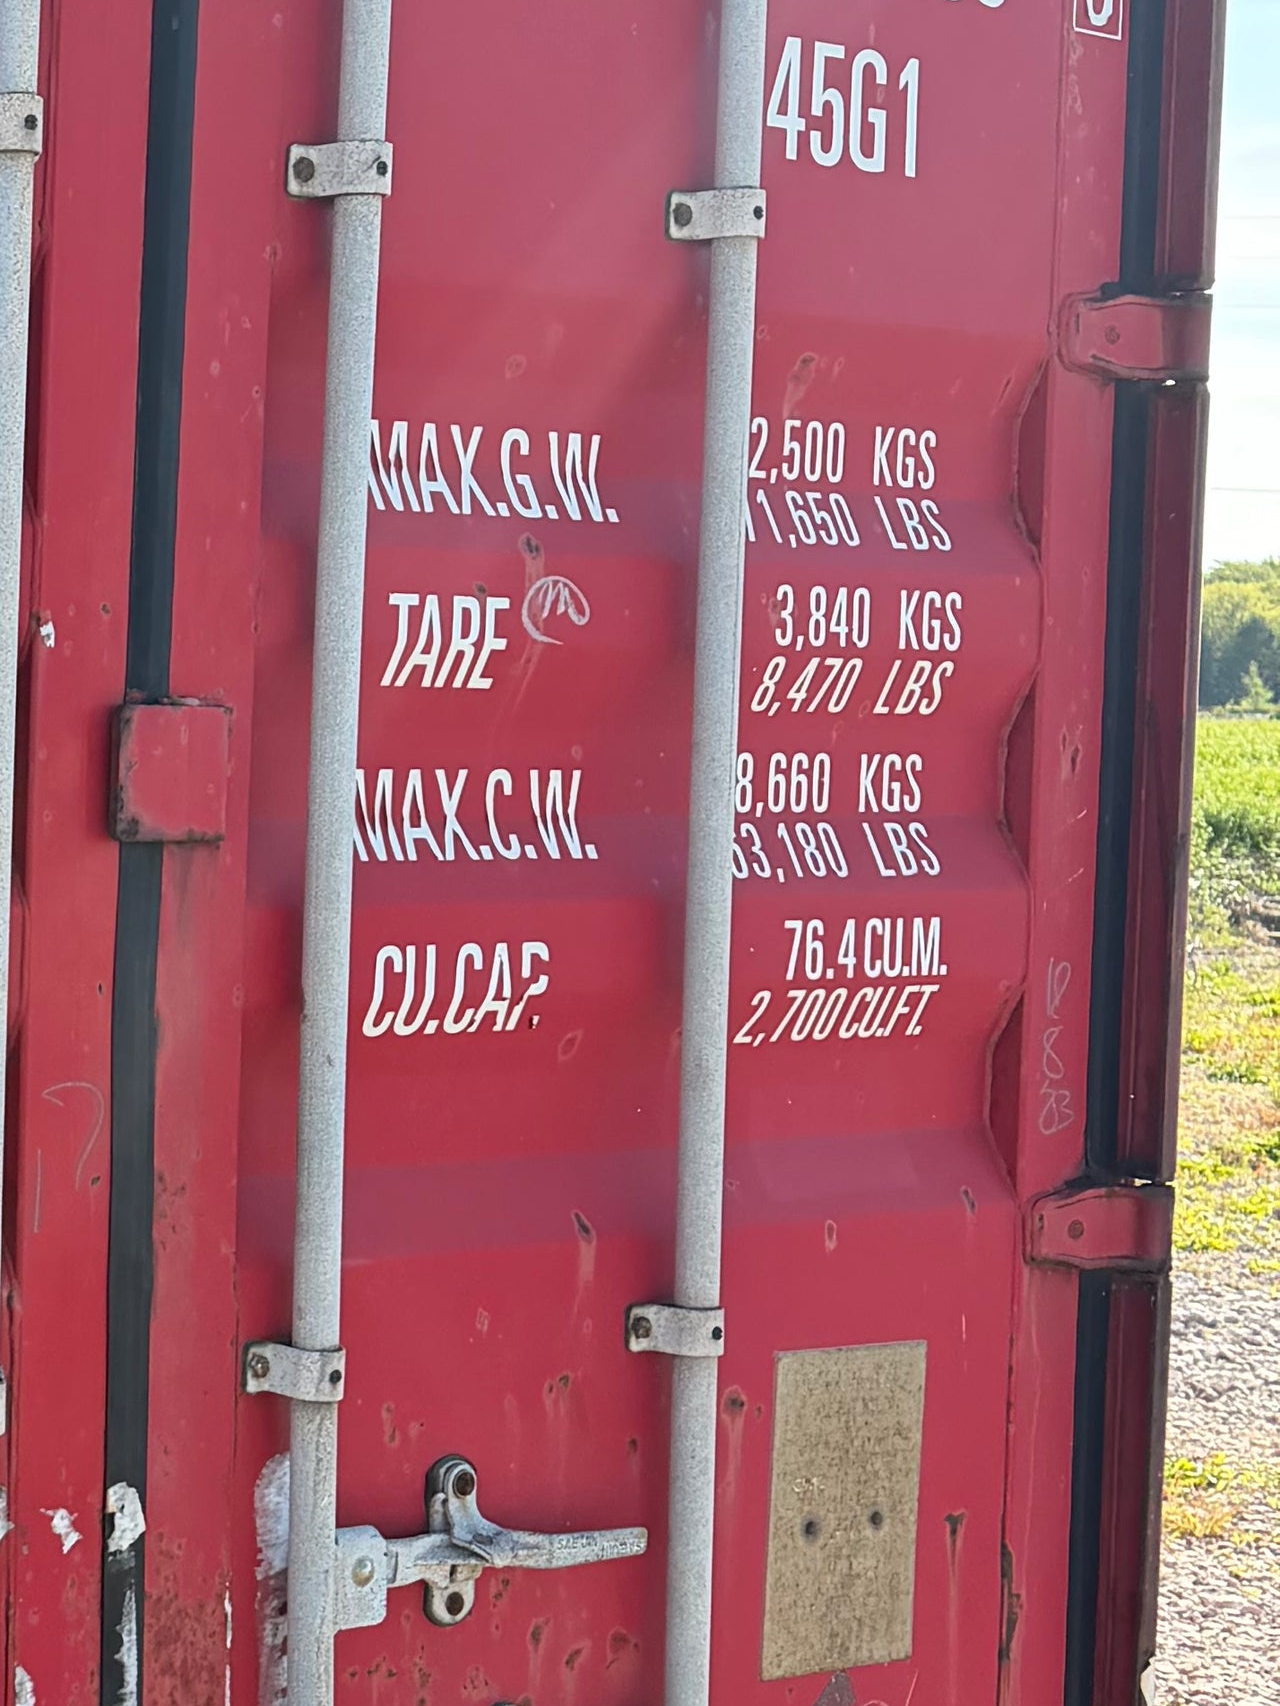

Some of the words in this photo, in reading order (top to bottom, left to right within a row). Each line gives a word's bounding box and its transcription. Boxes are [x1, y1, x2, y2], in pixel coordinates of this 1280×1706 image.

[766, 35, 920, 178] 45G1
[368, 420, 620, 523] MAX.G.W.
[873, 425, 937, 490] KGS
[881, 496, 951, 552] LBS
[380, 592, 510, 690] TARE
[774, 584, 871, 650] 3,840
[899, 590, 962, 652] KGS
[751, 657, 862, 717] 8,470
[874, 660, 952, 716] LBS
[354, 768, 598, 862] MAX.C.W.
[859, 753, 922, 814] KGS
[865, 821, 941, 877] LBS
